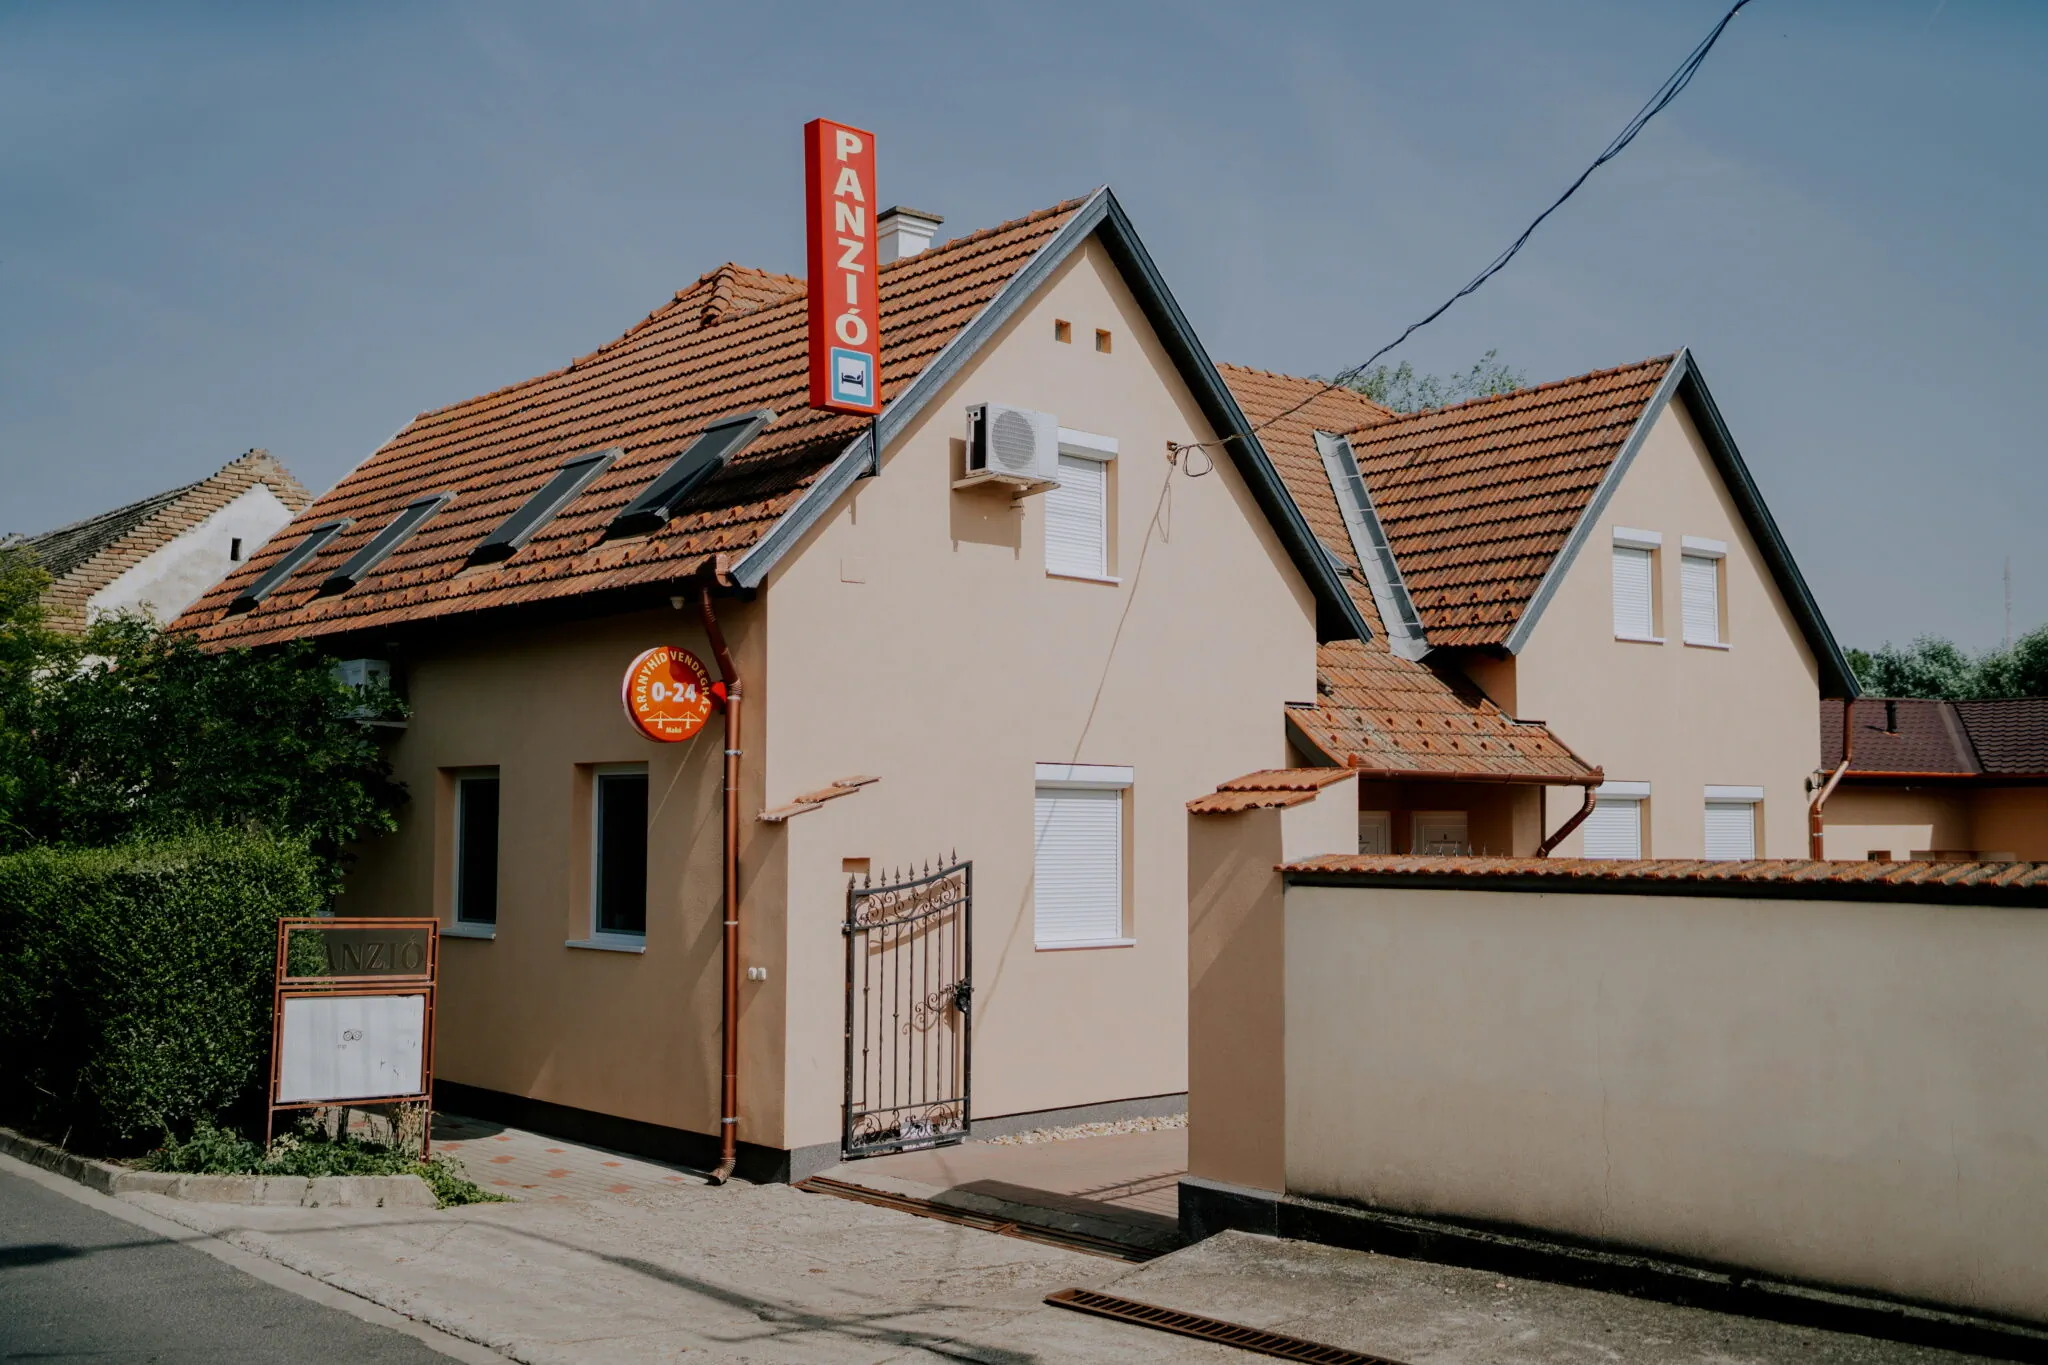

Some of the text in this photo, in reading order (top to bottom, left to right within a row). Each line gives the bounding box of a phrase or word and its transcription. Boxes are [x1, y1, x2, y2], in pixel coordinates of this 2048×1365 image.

[832, 129, 868, 346] PANZIÓ
[652, 682, 697, 703] 0-24
[318, 933, 424, 972] ANZIÓ
